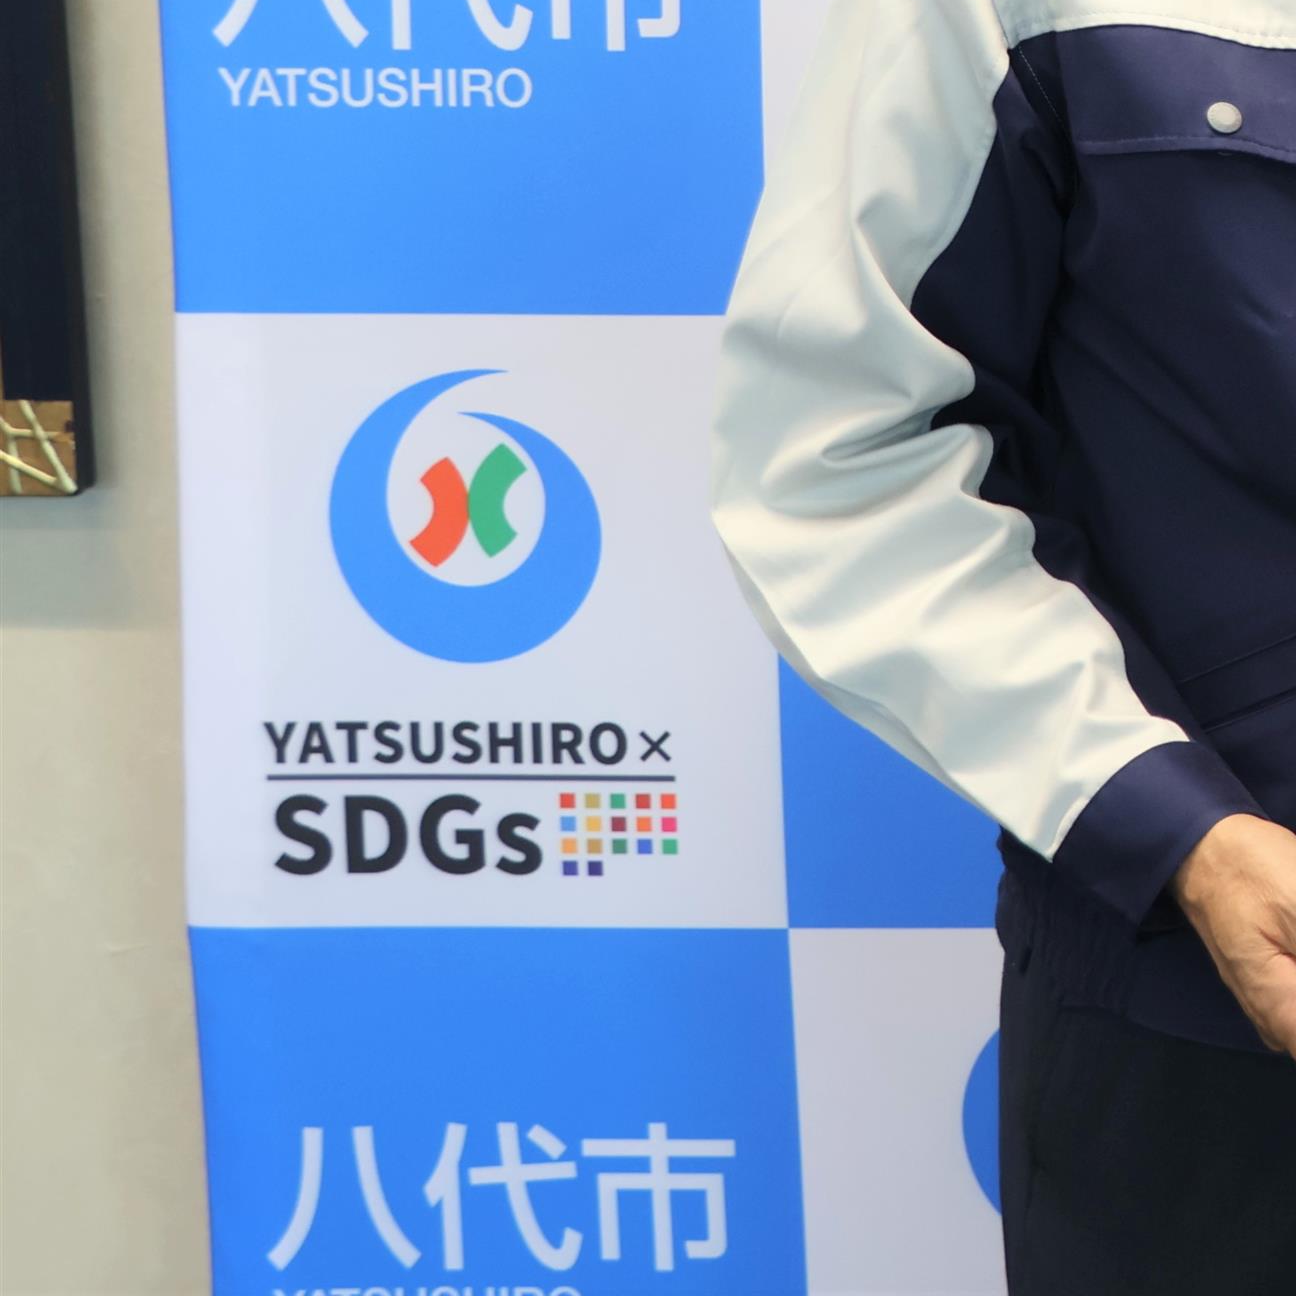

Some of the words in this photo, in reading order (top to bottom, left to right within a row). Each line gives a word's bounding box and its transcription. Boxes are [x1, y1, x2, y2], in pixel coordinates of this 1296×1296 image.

[220, 68, 533, 109] YATSUSHIRO
[276, 795, 543, 876] SDGs
[270, 1124, 736, 1271] 八代市
